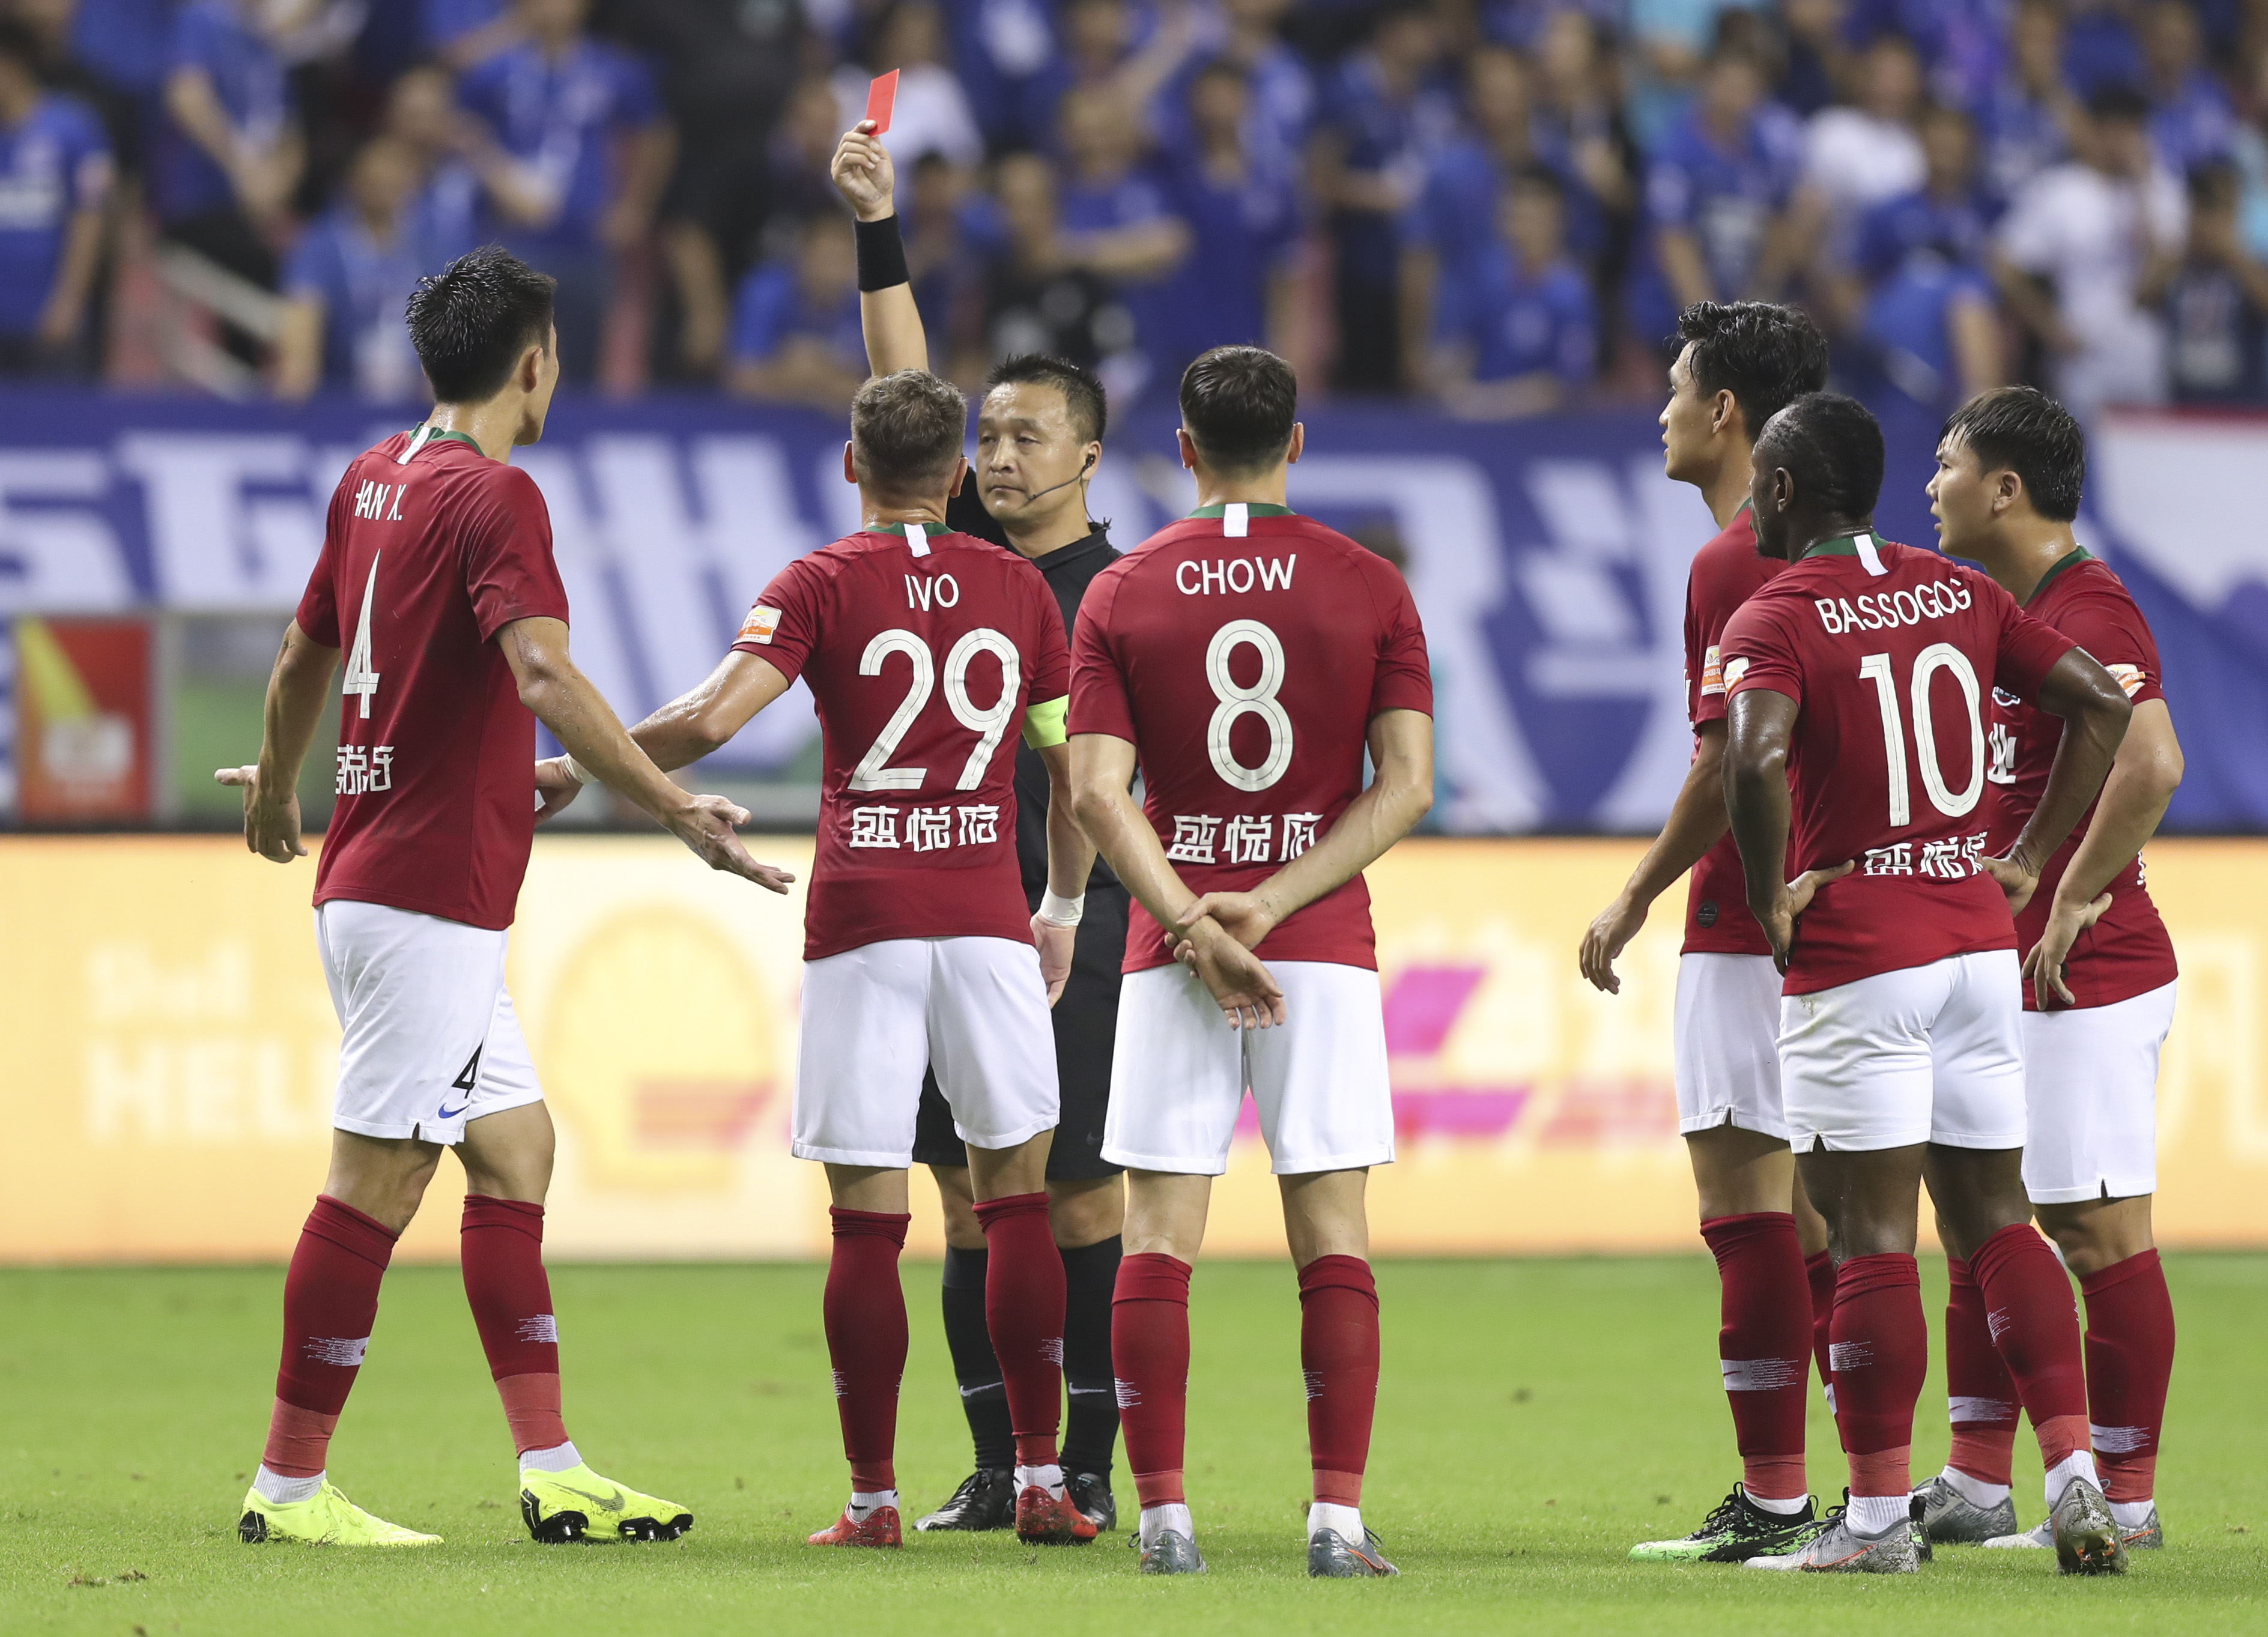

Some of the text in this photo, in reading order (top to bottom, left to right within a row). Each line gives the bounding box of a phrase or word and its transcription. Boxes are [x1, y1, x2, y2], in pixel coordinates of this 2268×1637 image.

[904, 574, 959, 612] IVO
[1175, 554, 1296, 595] CHOW
[342, 548, 380, 718] 4
[1815, 578, 1971, 634] BASSOGOG
[847, 628, 1020, 791] 29
[1205, 619, 1293, 791] 8
[1860, 643, 1984, 826] 10
[849, 805, 999, 852] 盛悦府
[451, 1037, 484, 1099] 4
